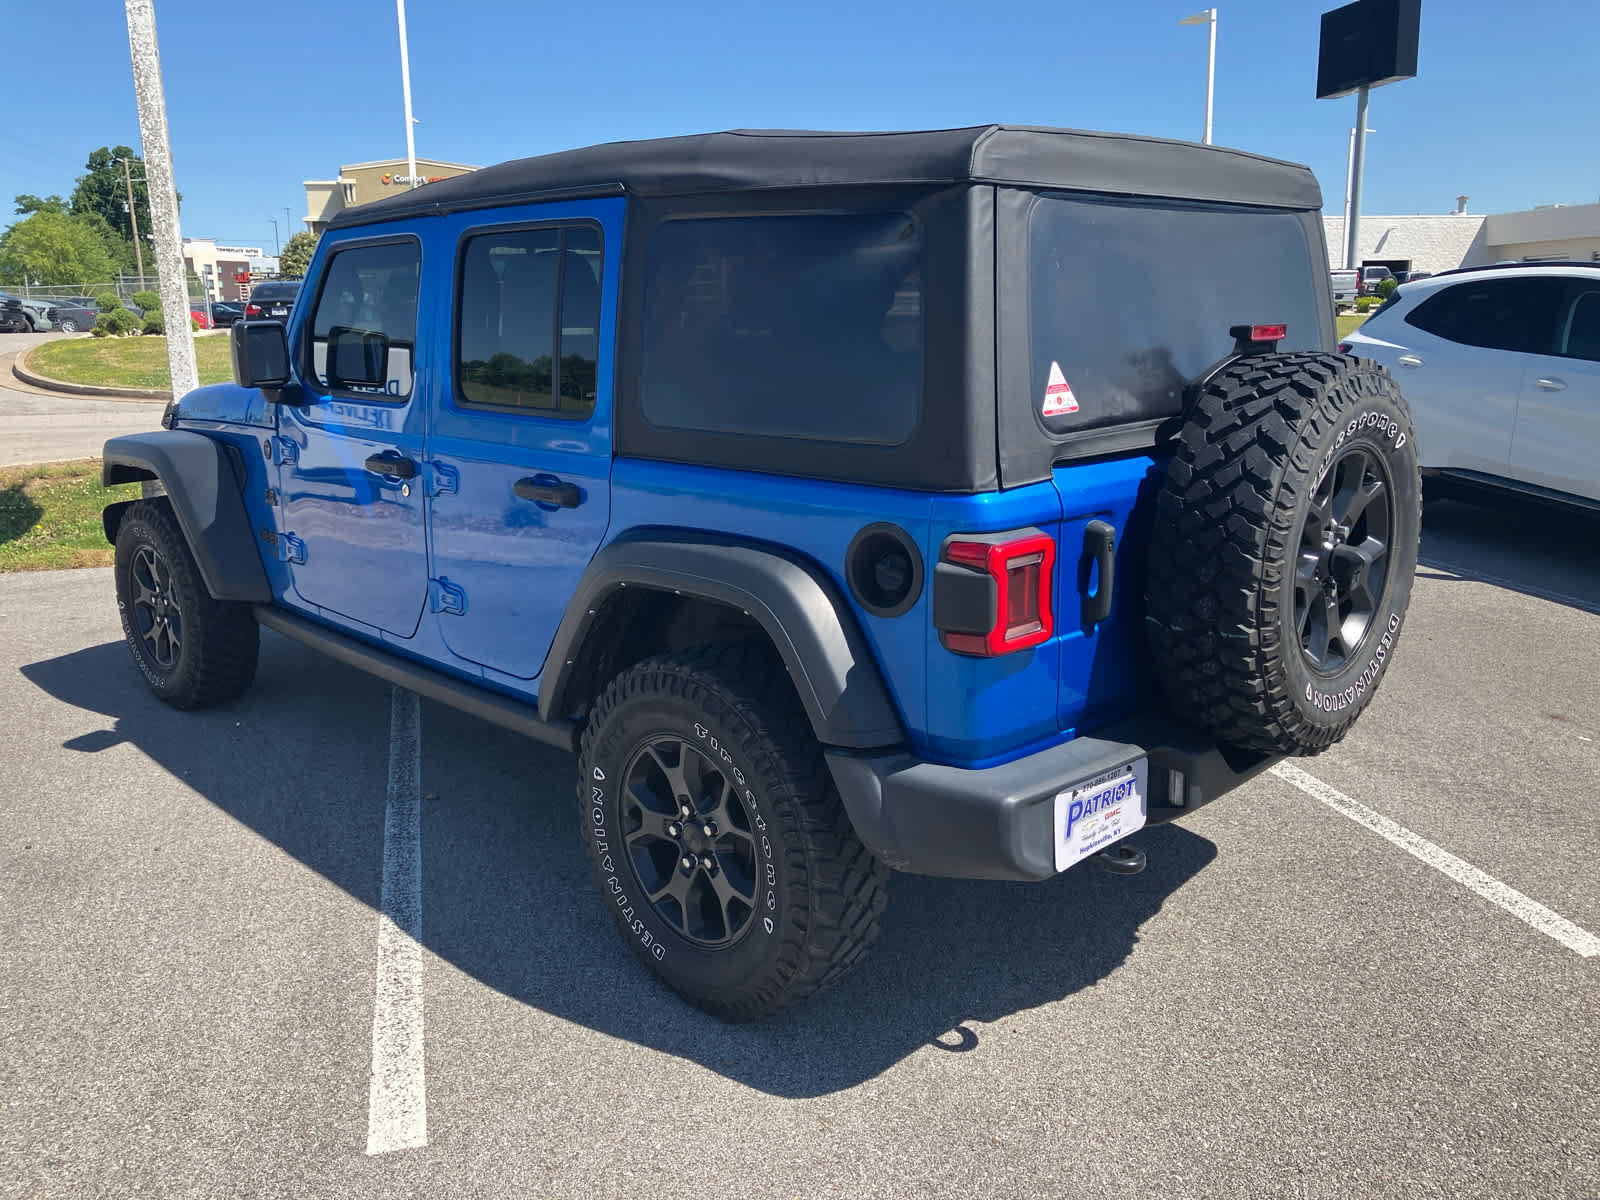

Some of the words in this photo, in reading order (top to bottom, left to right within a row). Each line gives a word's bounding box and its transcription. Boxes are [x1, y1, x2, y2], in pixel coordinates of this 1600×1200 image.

[393, 174, 426, 184] Comort
[1314, 613, 1400, 712] DESTINATION
[694, 722, 776, 910] Firestone
[1065, 778, 1136, 838] PATRIOT
[1104, 808, 1121, 820] GMC
[1113, 828, 1121, 836] KY
[592, 786, 666, 960] DESTINATION
